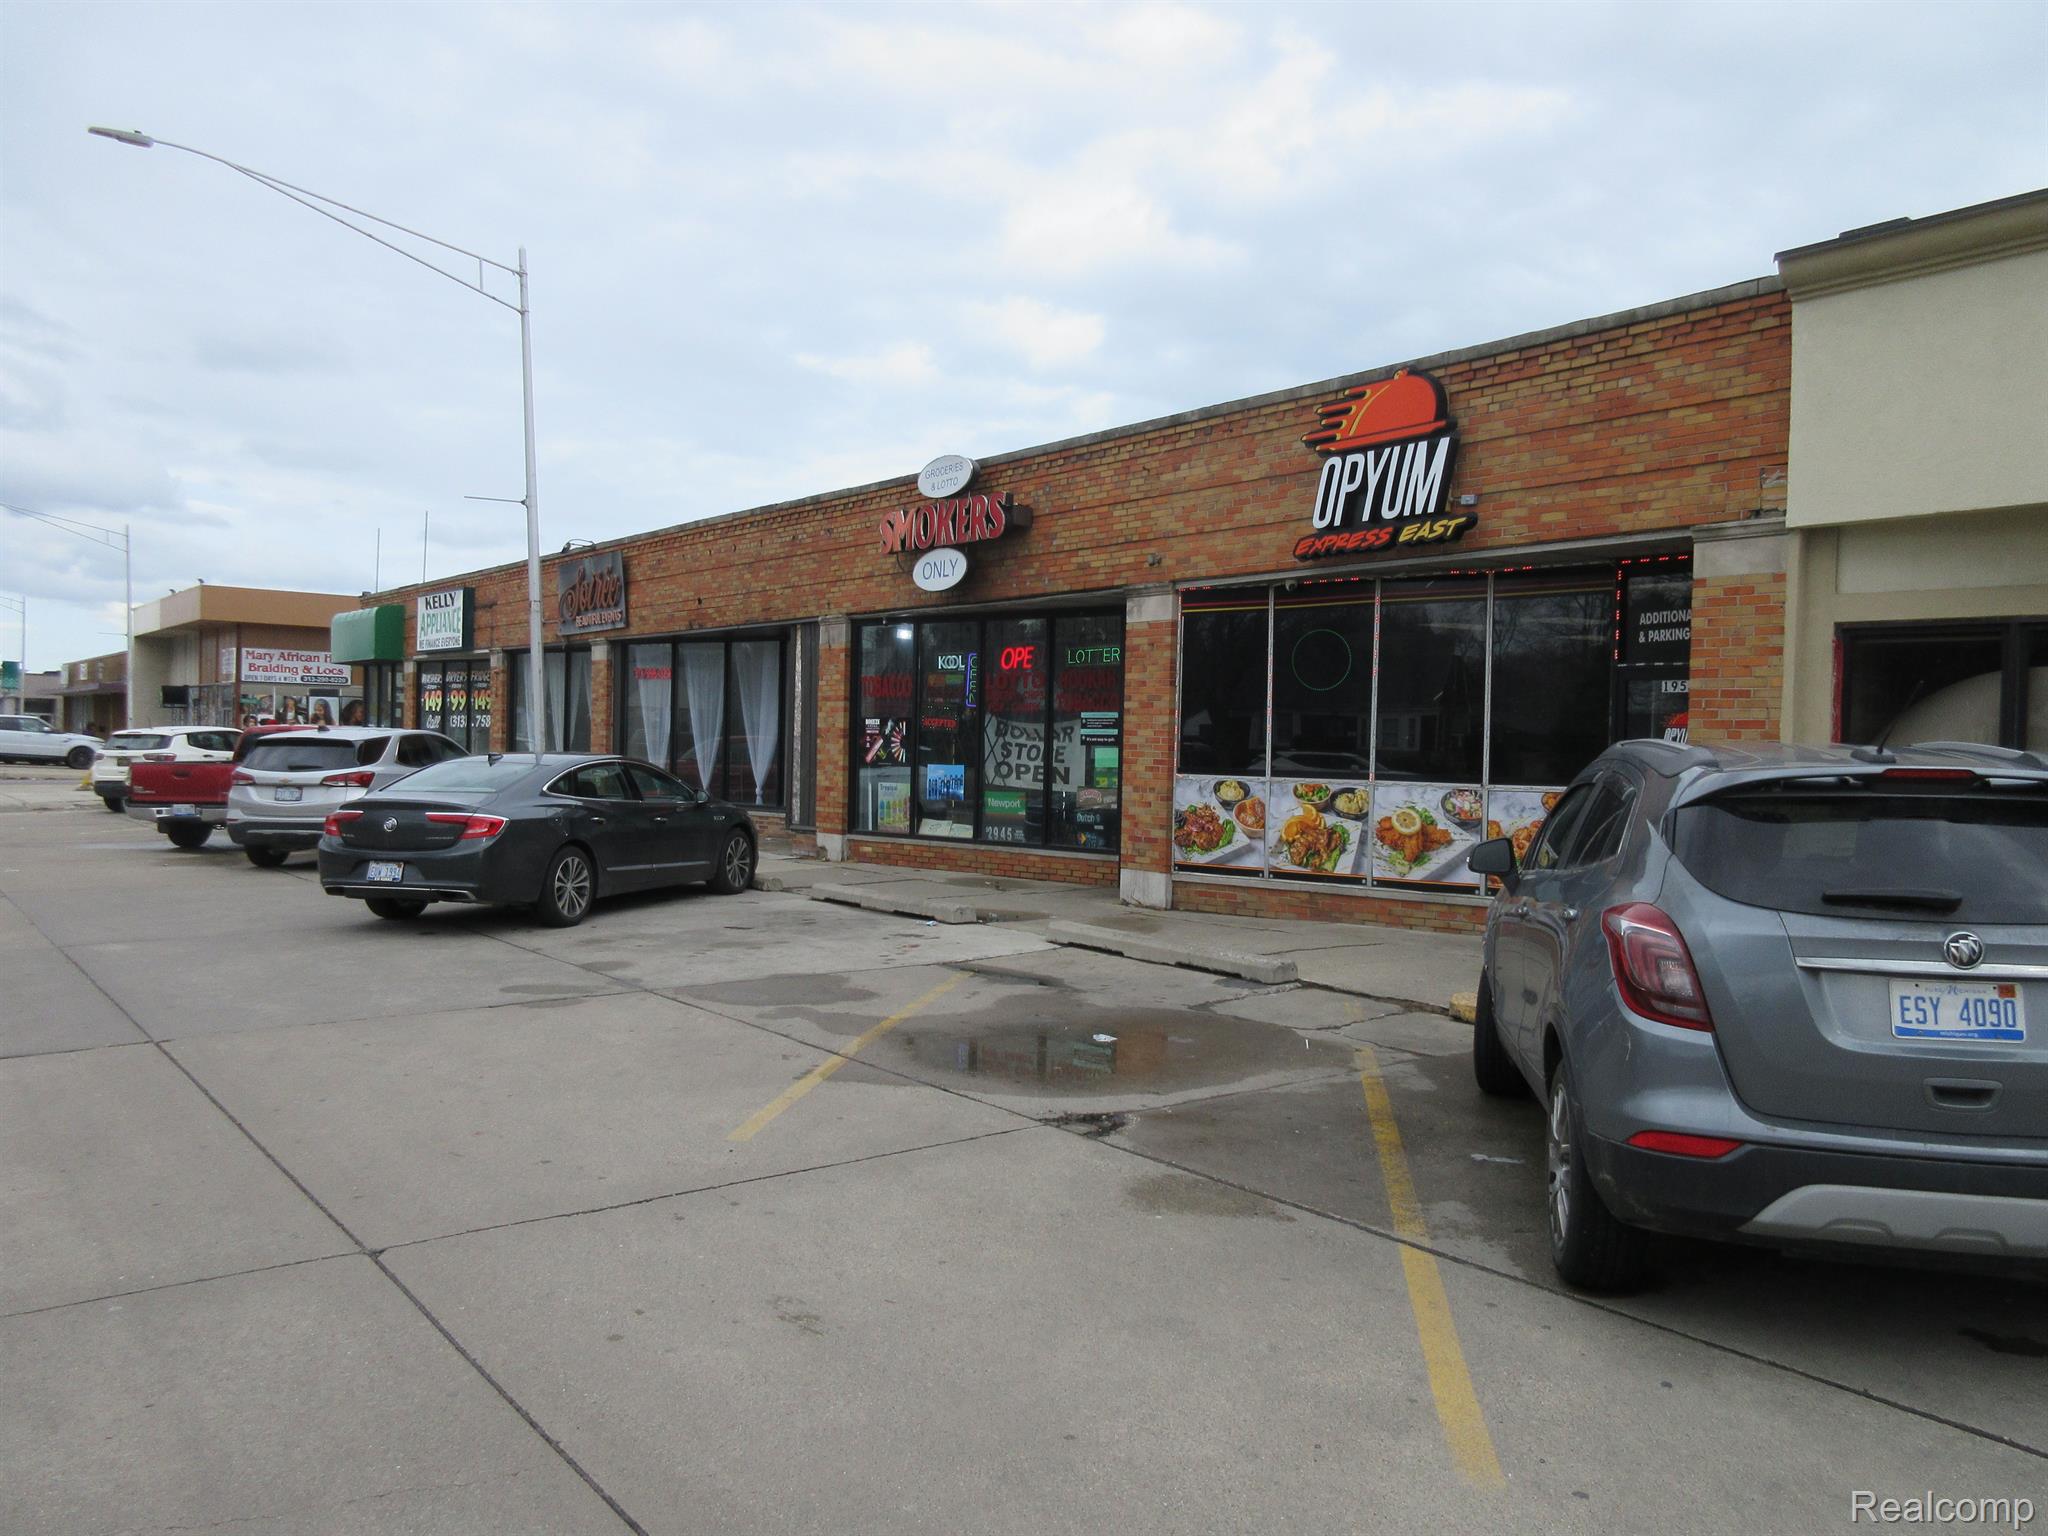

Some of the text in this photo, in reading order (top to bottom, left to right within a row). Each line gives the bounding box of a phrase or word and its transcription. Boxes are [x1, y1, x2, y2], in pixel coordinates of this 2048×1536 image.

[925, 462, 964, 480] GROCERIES
[931, 478, 959, 492] & LOTTO
[1312, 437, 1450, 529] OPYUM
[880, 491, 1006, 554] SMOKERS
[1295, 517, 1467, 555] EXPRESS EAST
[922, 558, 959, 580] ONLY
[425, 591, 457, 610] KELLY
[420, 607, 462, 639] APPLIANCE
[1638, 627, 1690, 643] & PARKING
[245, 650, 274, 663] Mary
[278, 652, 320, 663] African
[938, 655, 965, 670] KOOL
[248, 663, 345, 676] Braiding & Locs
[1001, 742, 1067, 763] STOE
[994, 761, 1071, 785] OPEN
[988, 798, 1021, 809] Newport
[1900, 996, 2017, 1029] ESY 4090
